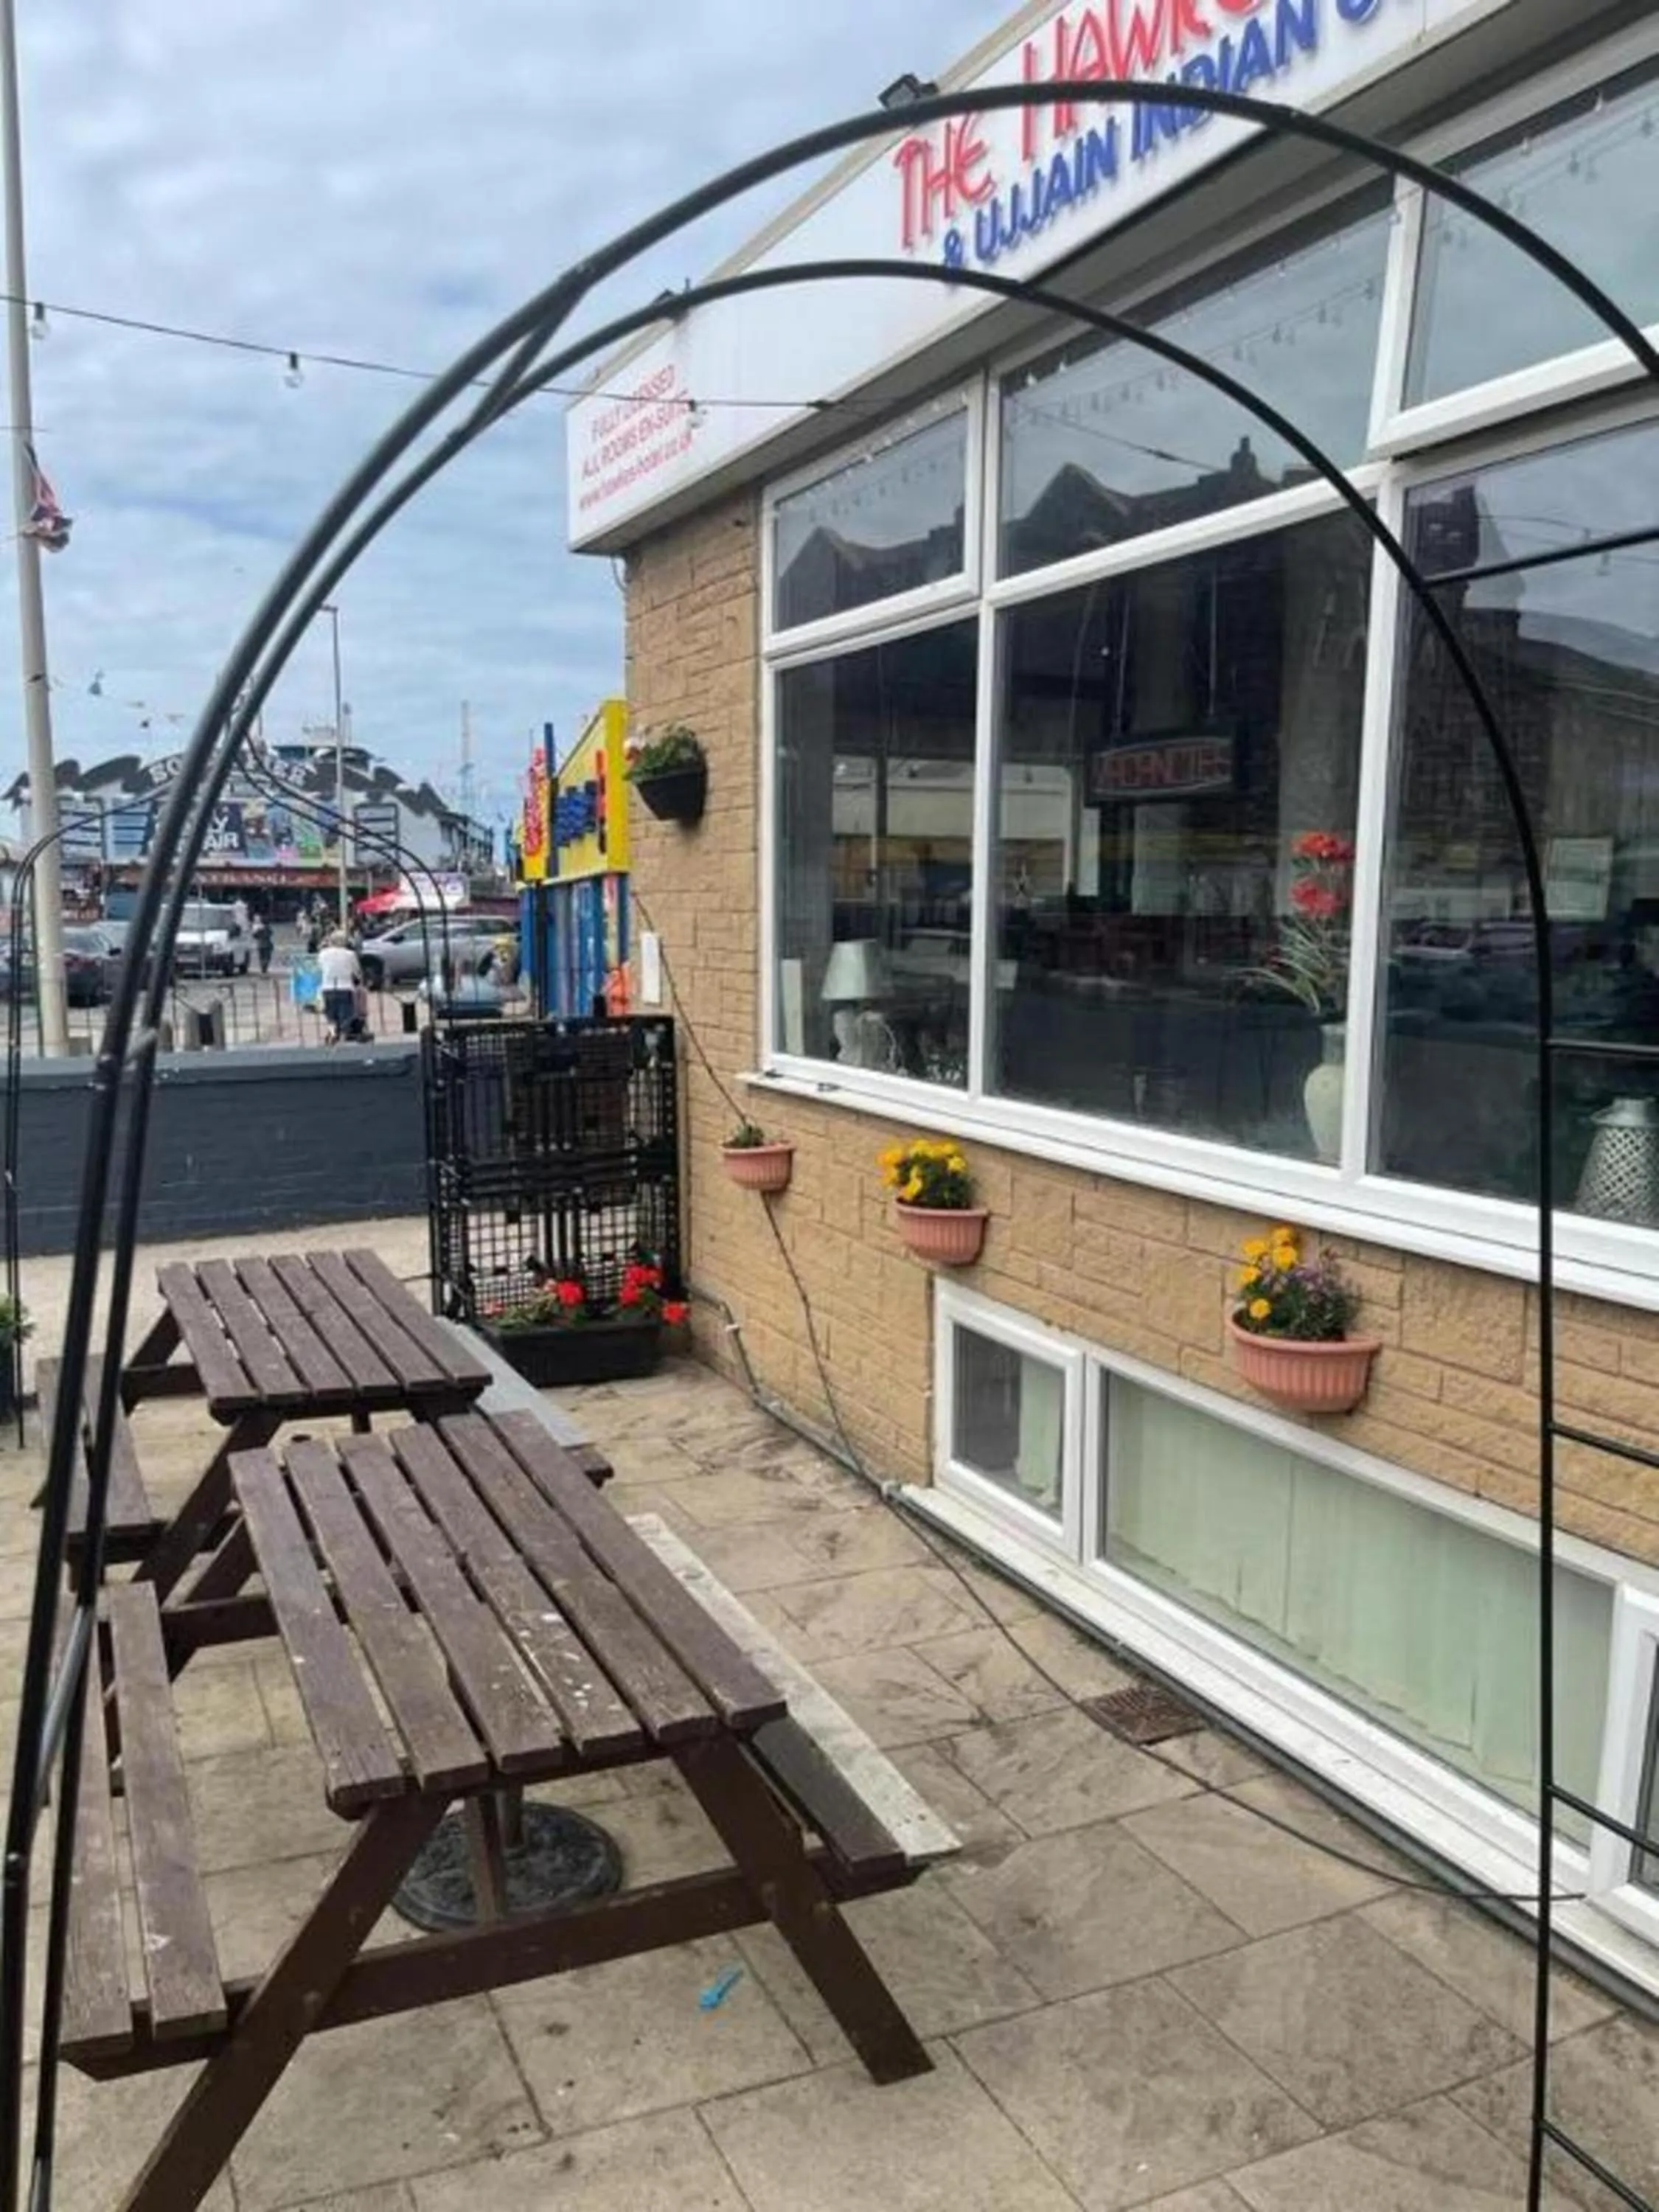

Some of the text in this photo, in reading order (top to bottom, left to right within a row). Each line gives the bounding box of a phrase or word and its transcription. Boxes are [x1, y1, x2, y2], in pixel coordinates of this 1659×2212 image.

[893, 112, 995, 251] THE
[975, 116, 1117, 263] UJJAIN
[1130, 0, 1317, 161] INDIAN
